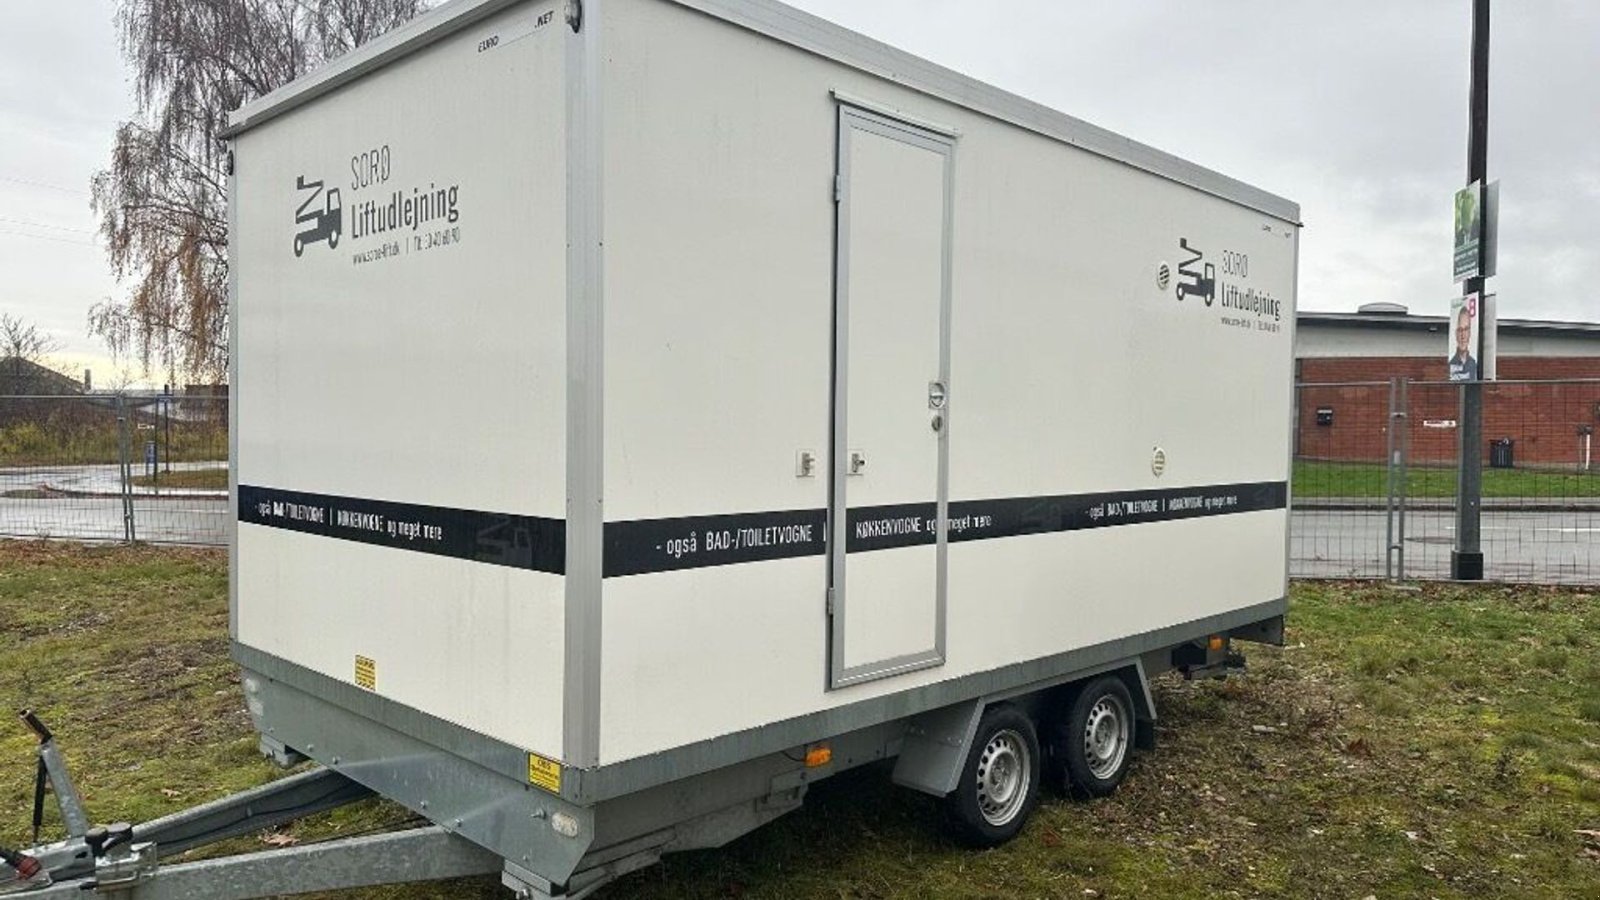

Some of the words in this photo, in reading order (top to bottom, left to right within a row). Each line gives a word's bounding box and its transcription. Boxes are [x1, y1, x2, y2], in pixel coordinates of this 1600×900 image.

[351, 145, 390, 190] SORØ
[352, 183, 459, 240] Liftudlejning
[667, 531, 697, 559] også
